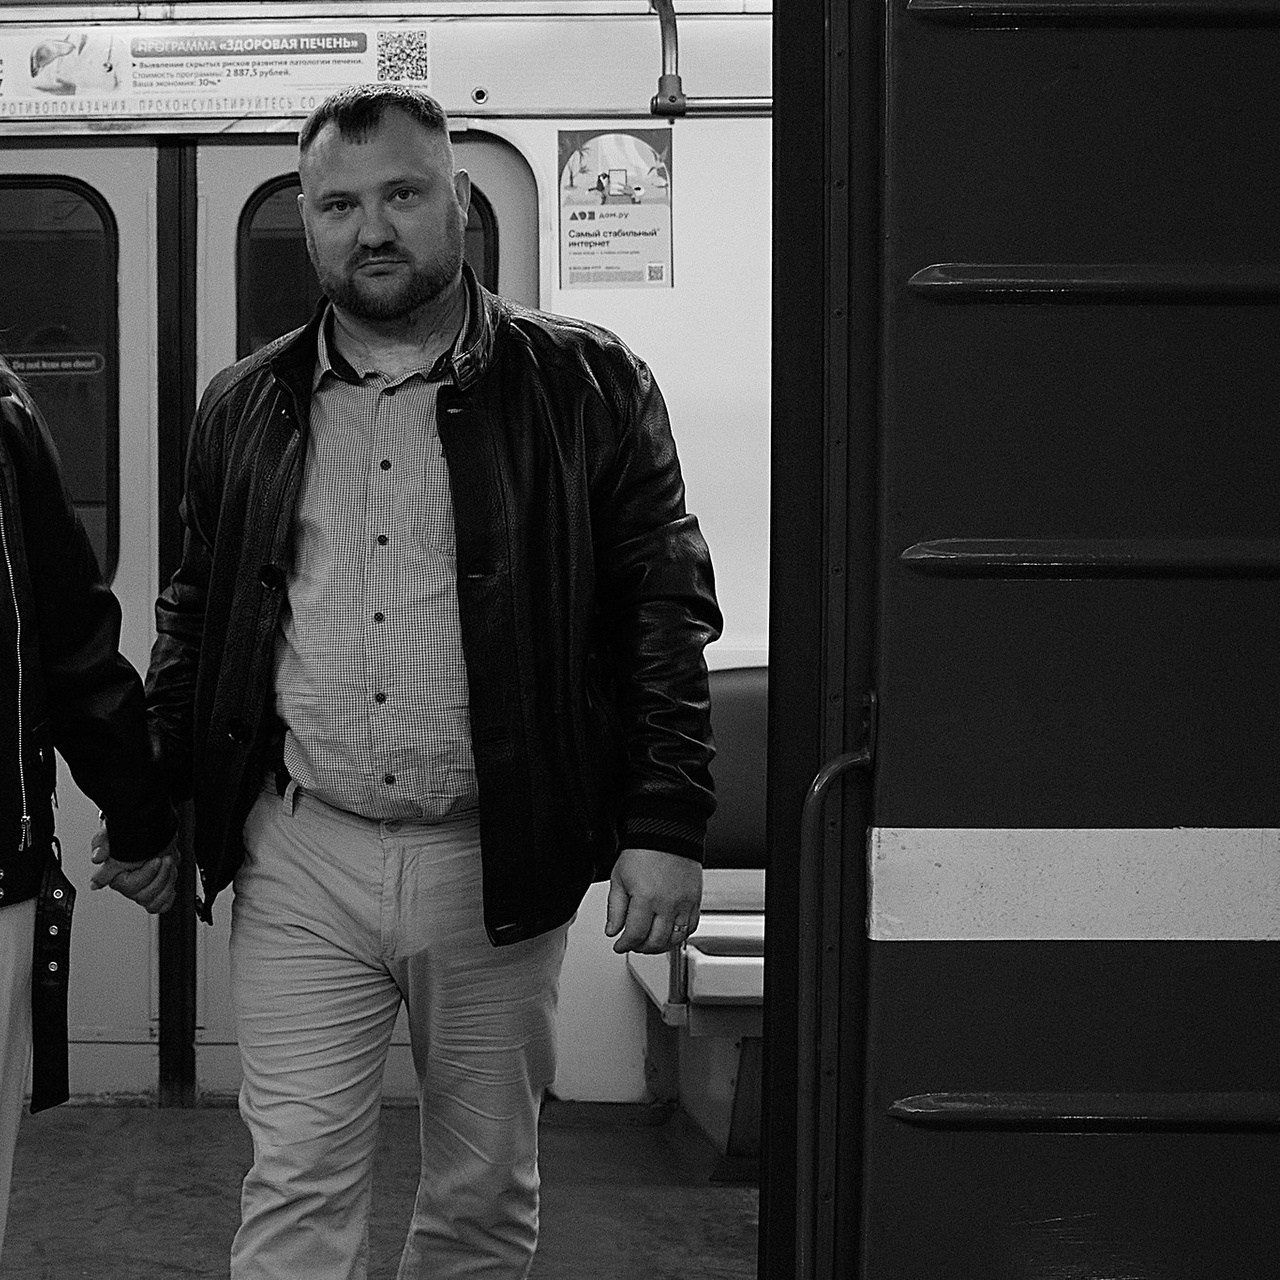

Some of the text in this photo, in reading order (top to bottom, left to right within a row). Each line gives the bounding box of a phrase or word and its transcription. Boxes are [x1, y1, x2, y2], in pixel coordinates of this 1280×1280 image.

[138, 36, 359, 53] ПРОГРАММА «ЗДОРОВАЯ ПЕЧЕНЬ»
[185, 61, 220, 70] скрытых
[132, 70, 174, 79] Стоимость
[225, 68, 231, 77] 2
[233, 67, 258, 78] 887,5
[259, 68, 291, 78] рублей.
[132, 80, 154, 88] Ваша
[568, 229, 601, 239] Самый
[568, 240, 610, 249] интернет
